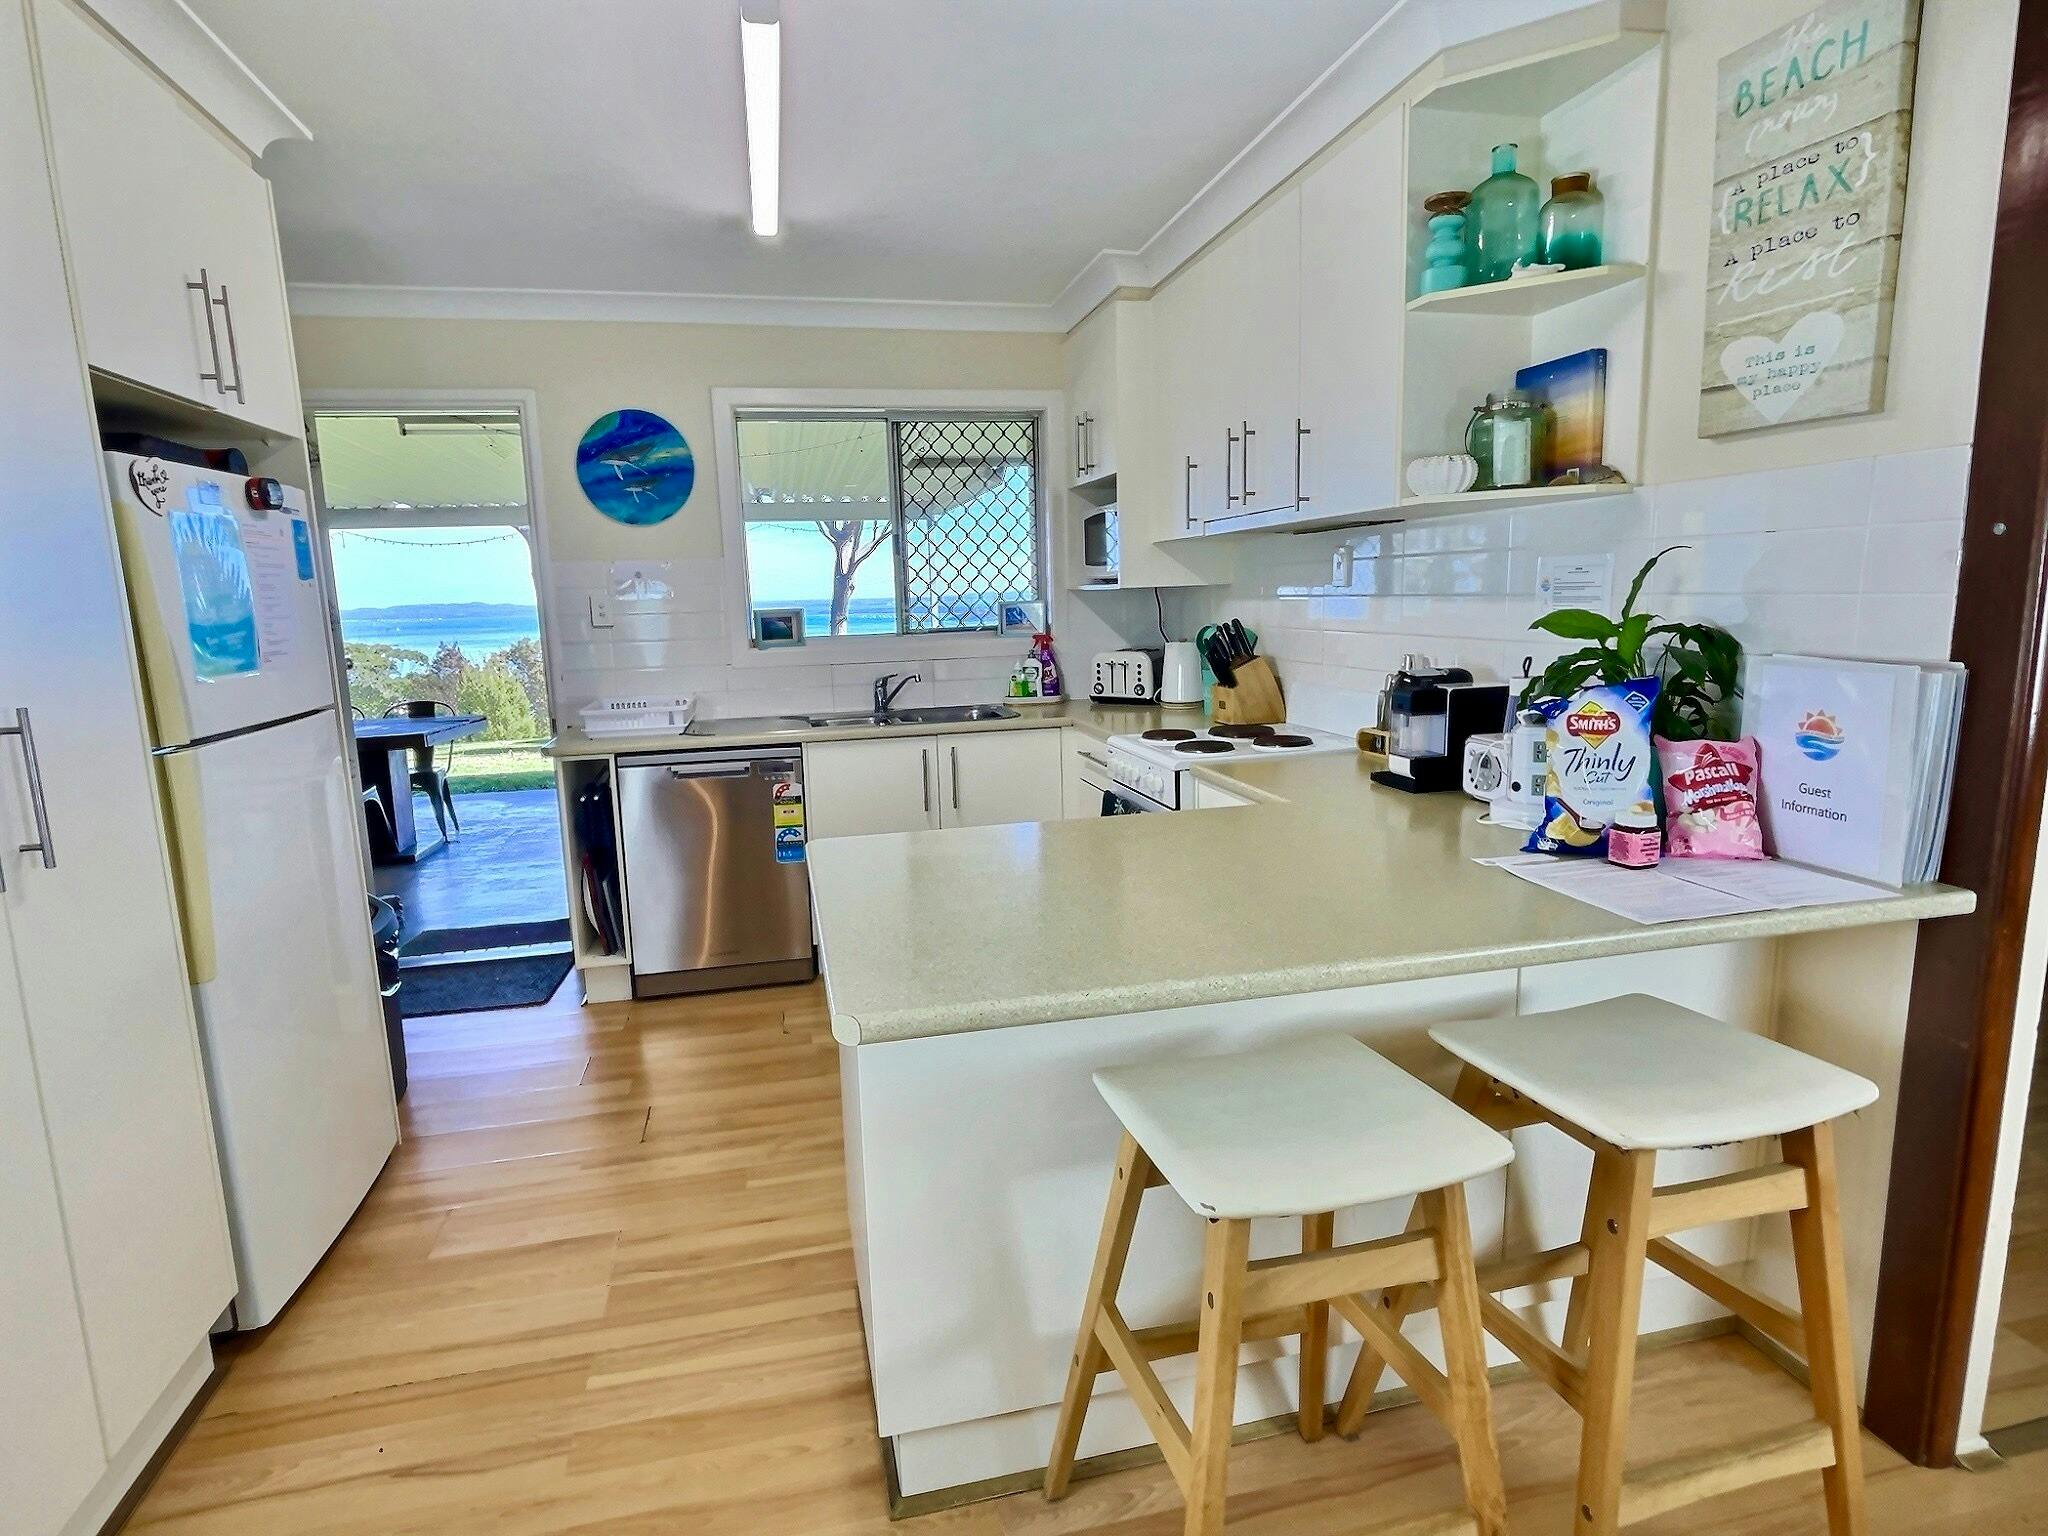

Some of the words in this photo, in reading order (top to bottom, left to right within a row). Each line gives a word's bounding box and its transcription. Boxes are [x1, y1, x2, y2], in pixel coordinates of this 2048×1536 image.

[1734, 20, 1868, 118] BEACH
[1730, 184, 1744, 197] A
[1757, 152, 1820, 189] place
[1835, 136, 1859, 154] to
[1732, 157, 1854, 234] RELAX
[1723, 255, 1738, 267] A
[1751, 226, 1818, 262] place
[1832, 212, 1860, 231] to
[1745, 350, 1785, 368] This
[1794, 344, 1816, 357] is
[1767, 361, 1822, 380] happy
[1752, 381, 1801, 400] place
[1568, 715, 1617, 731] SMITH'S
[1564, 741, 1636, 781] Thinly
[1684, 762, 1740, 785] Pascall
[1798, 782, 1832, 800] Guest
[1781, 799, 1848, 823] Information
